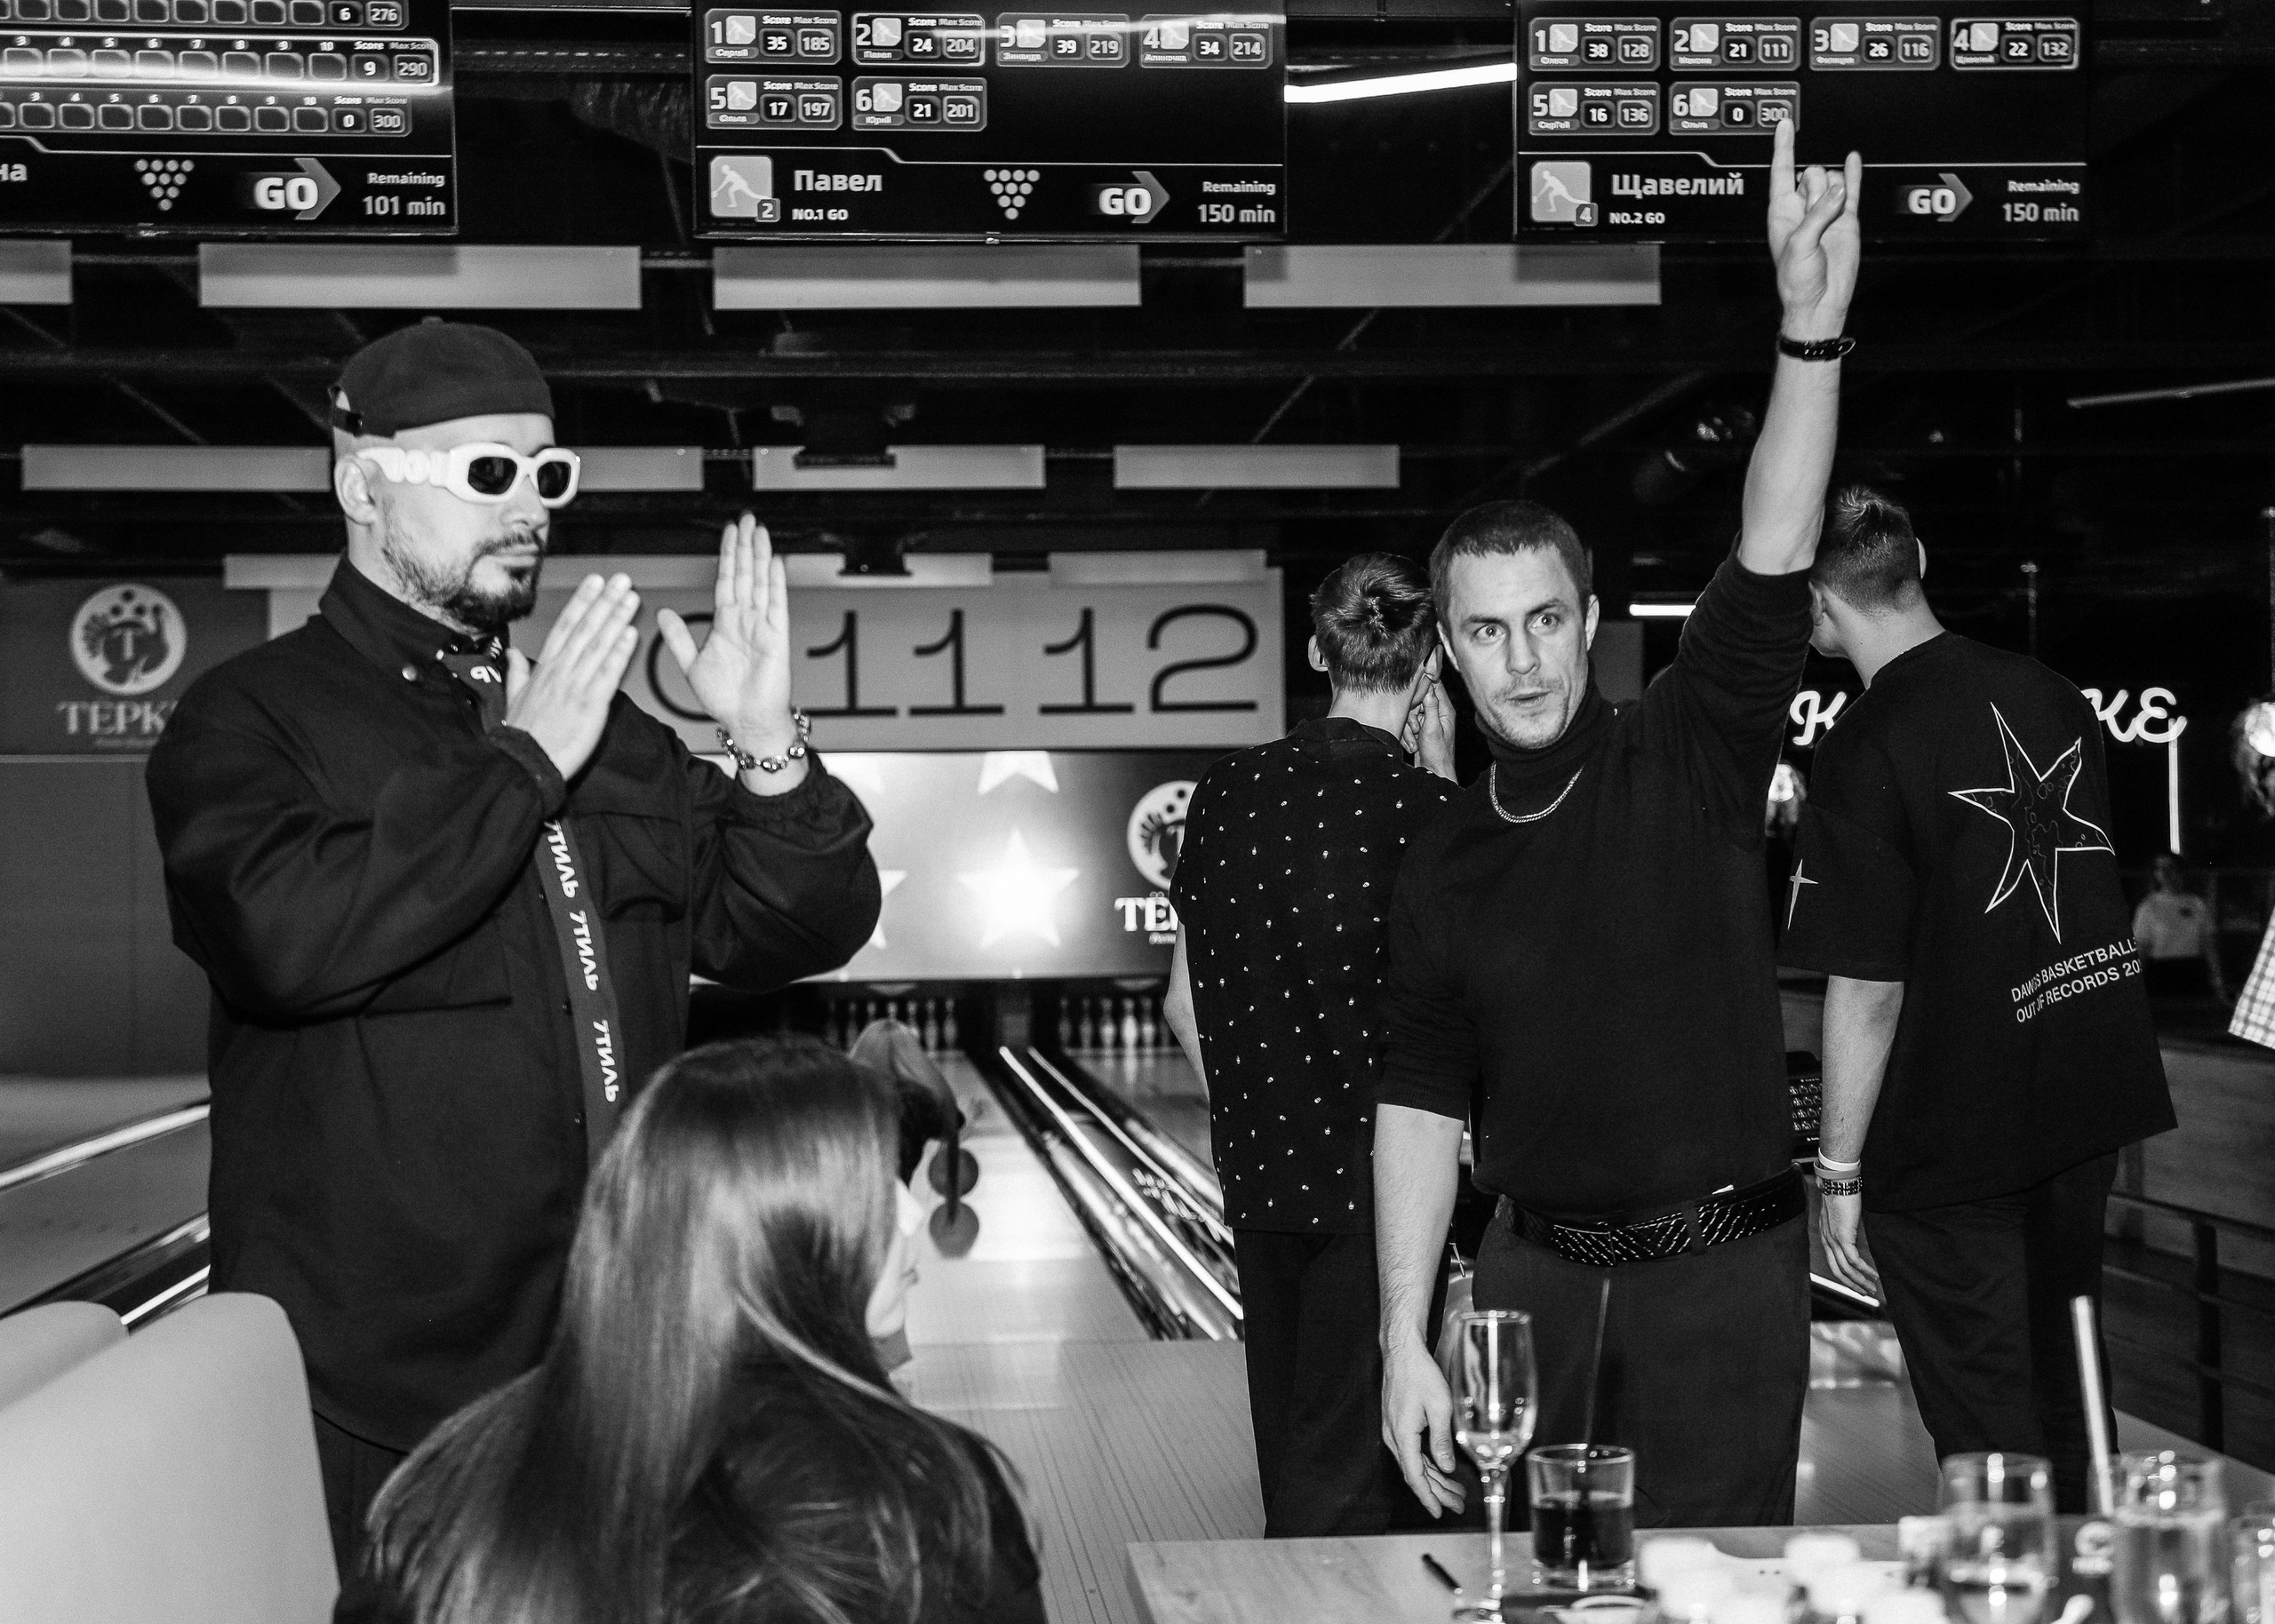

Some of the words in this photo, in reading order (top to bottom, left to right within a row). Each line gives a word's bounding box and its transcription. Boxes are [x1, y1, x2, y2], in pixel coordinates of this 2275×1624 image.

[339, 8, 351, 20] 6
[371, 8, 398, 21] 276
[762, 15, 792, 25] Score
[908, 17, 937, 27] Score
[1052, 19, 1082, 28] Score
[1195, 20, 1225, 29] Score
[1585, 22, 1613, 32] Score
[1632, 23, 1657, 32] Score
[1725, 22, 1753, 32] Score
[1865, 22, 1893, 32] Score
[2005, 21, 2033, 31] Score
[711, 20, 722, 44] 1
[856, 23, 871, 45] 2
[1000, 25, 1016, 48] 3
[1143, 26, 1161, 49] 4
[1953, 28, 1970, 51] 4
[16, 36, 27, 46] 3
[60, 36, 71, 47] 4
[105, 37, 115, 48] 5
[148, 38, 159, 49] 6
[192, 38, 202, 49] 7
[235, 40, 245, 50] 8
[278, 40, 288, 51] 9
[320, 41, 334, 52] 10
[354, 41, 385, 50] Score
[767, 36, 787, 51] 35
[802, 36, 830, 51] 185
[913, 37, 933, 52] 24
[946, 38, 975, 52] 204
[1057, 40, 1077, 54] 39
[1090, 40, 1119, 54] 219
[1200, 41, 1220, 55] 34
[1233, 42, 1261, 55] 214
[1535, 29, 1546, 52] 1
[1673, 29, 1689, 52] 2
[1814, 29, 1830, 52] 3
[1589, 44, 1608, 58] 38
[1623, 44, 1649, 58] 128
[1729, 43, 1747, 58] 21
[1763, 44, 1788, 58] 111
[1869, 43, 1889, 57] 26
[1903, 43, 1929, 57] 116
[2008, 42, 2028, 56] 22
[2042, 42, 2069, 56] 132
[363, 61, 376, 76] 9
[398, 62, 428, 76] 290
[763, 81, 793, 90] Score
[813, 82, 839, 91] Score
[908, 83, 938, 92] Score
[1584, 87, 1612, 97] Score
[1724, 87, 1752, 97] Score
[29, 92, 41, 102] 3
[69, 92, 81, 103] 4
[109, 93, 120, 103] 5
[148, 93, 159, 104] 6
[188, 94, 197, 104] 7
[227, 95, 237, 105] 8
[266, 96, 275, 105] 9
[303, 96, 317, 106] 10
[334, 96, 363, 105] Score
[711, 87, 727, 110] 5
[856, 89, 872, 111] 6
[1533, 94, 1548, 116] 5
[1672, 94, 1688, 116] 6
[769, 101, 788, 116] 17
[803, 102, 831, 116] 197
[913, 103, 931, 117] 21
[947, 104, 974, 117] 201
[1589, 107, 1608, 122] 16
[1622, 107, 1648, 122] 136
[1732, 107, 1744, 122] 0
[1761, 107, 1789, 122] 300
[342, 115, 355, 128] 0
[374, 115, 401, 128] 300
[368, 171, 445, 187] Remaining
[794, 170, 882, 192] Павел
[1611, 172, 1744, 199] Щавелий
[254, 177, 319, 211] GO
[1202, 180, 1276, 195] Remaining
[2008, 179, 2080, 195] Remaining
[363, 195, 400, 215] 101
[407, 195, 446, 216] min
[1098, 187, 1152, 216] GO
[1908, 187, 1956, 214] GO
[762, 203, 774, 219] 2
[792, 208, 824, 220] NO.1
[826, 209, 849, 221] GO
[1197, 203, 1234, 222] 150
[1239, 203, 1276, 222] min
[1579, 206, 1592, 223] 4
[1609, 211, 1643, 224] NO.2
[1645, 212, 1665, 224] GO
[2002, 202, 2040, 222] 150
[2044, 202, 2080, 222] min
[1040, 602, 1258, 716] 12
[2040, 936, 2137, 984] BASKETBALL
[2016, 1001, 2037, 1023] OUT
[2046, 967, 2119, 1005] RECORDS
[2122, 959, 2143, 977] 20
